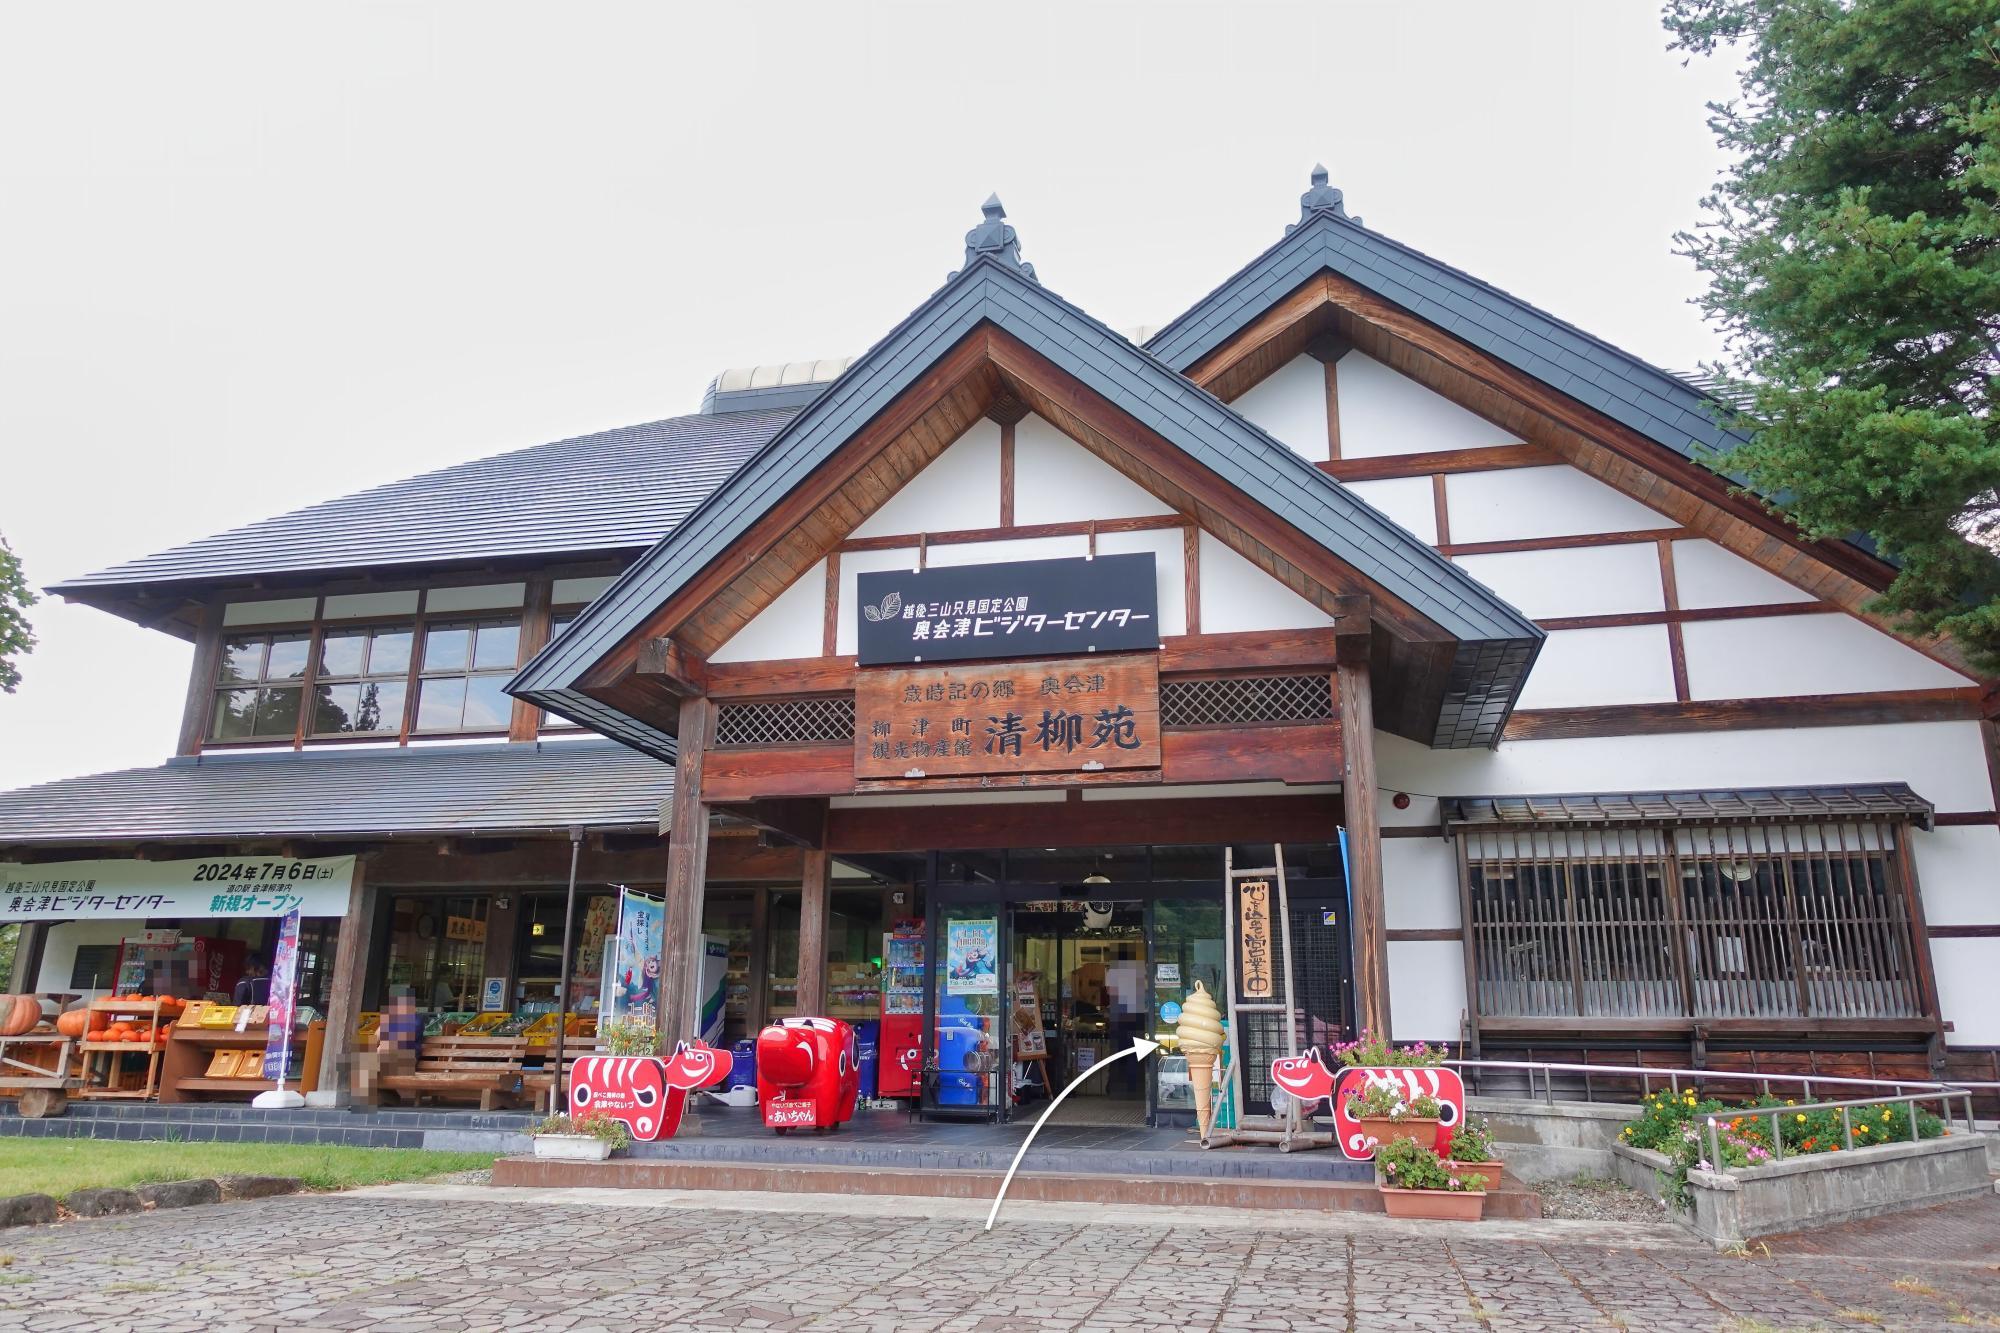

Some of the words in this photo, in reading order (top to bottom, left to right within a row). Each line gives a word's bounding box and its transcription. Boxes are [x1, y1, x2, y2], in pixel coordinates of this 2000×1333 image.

[902, 596, 1029, 619] 越後三山只見国定公園
[912, 608, 1150, 640] 奥会津ビジターセンター
[903, 679, 1016, 704] 歳時記の郷
[1040, 673, 1106, 696] 奥会津
[984, 704, 1142, 757] 清柳苑
[871, 738, 972, 760] 観光物産館
[5, 879, 97, 894] 越後三山只見国定公園
[8, 895, 175, 912] 奥会津ビジターセンター
[209, 894, 303, 912] 新規オープン
